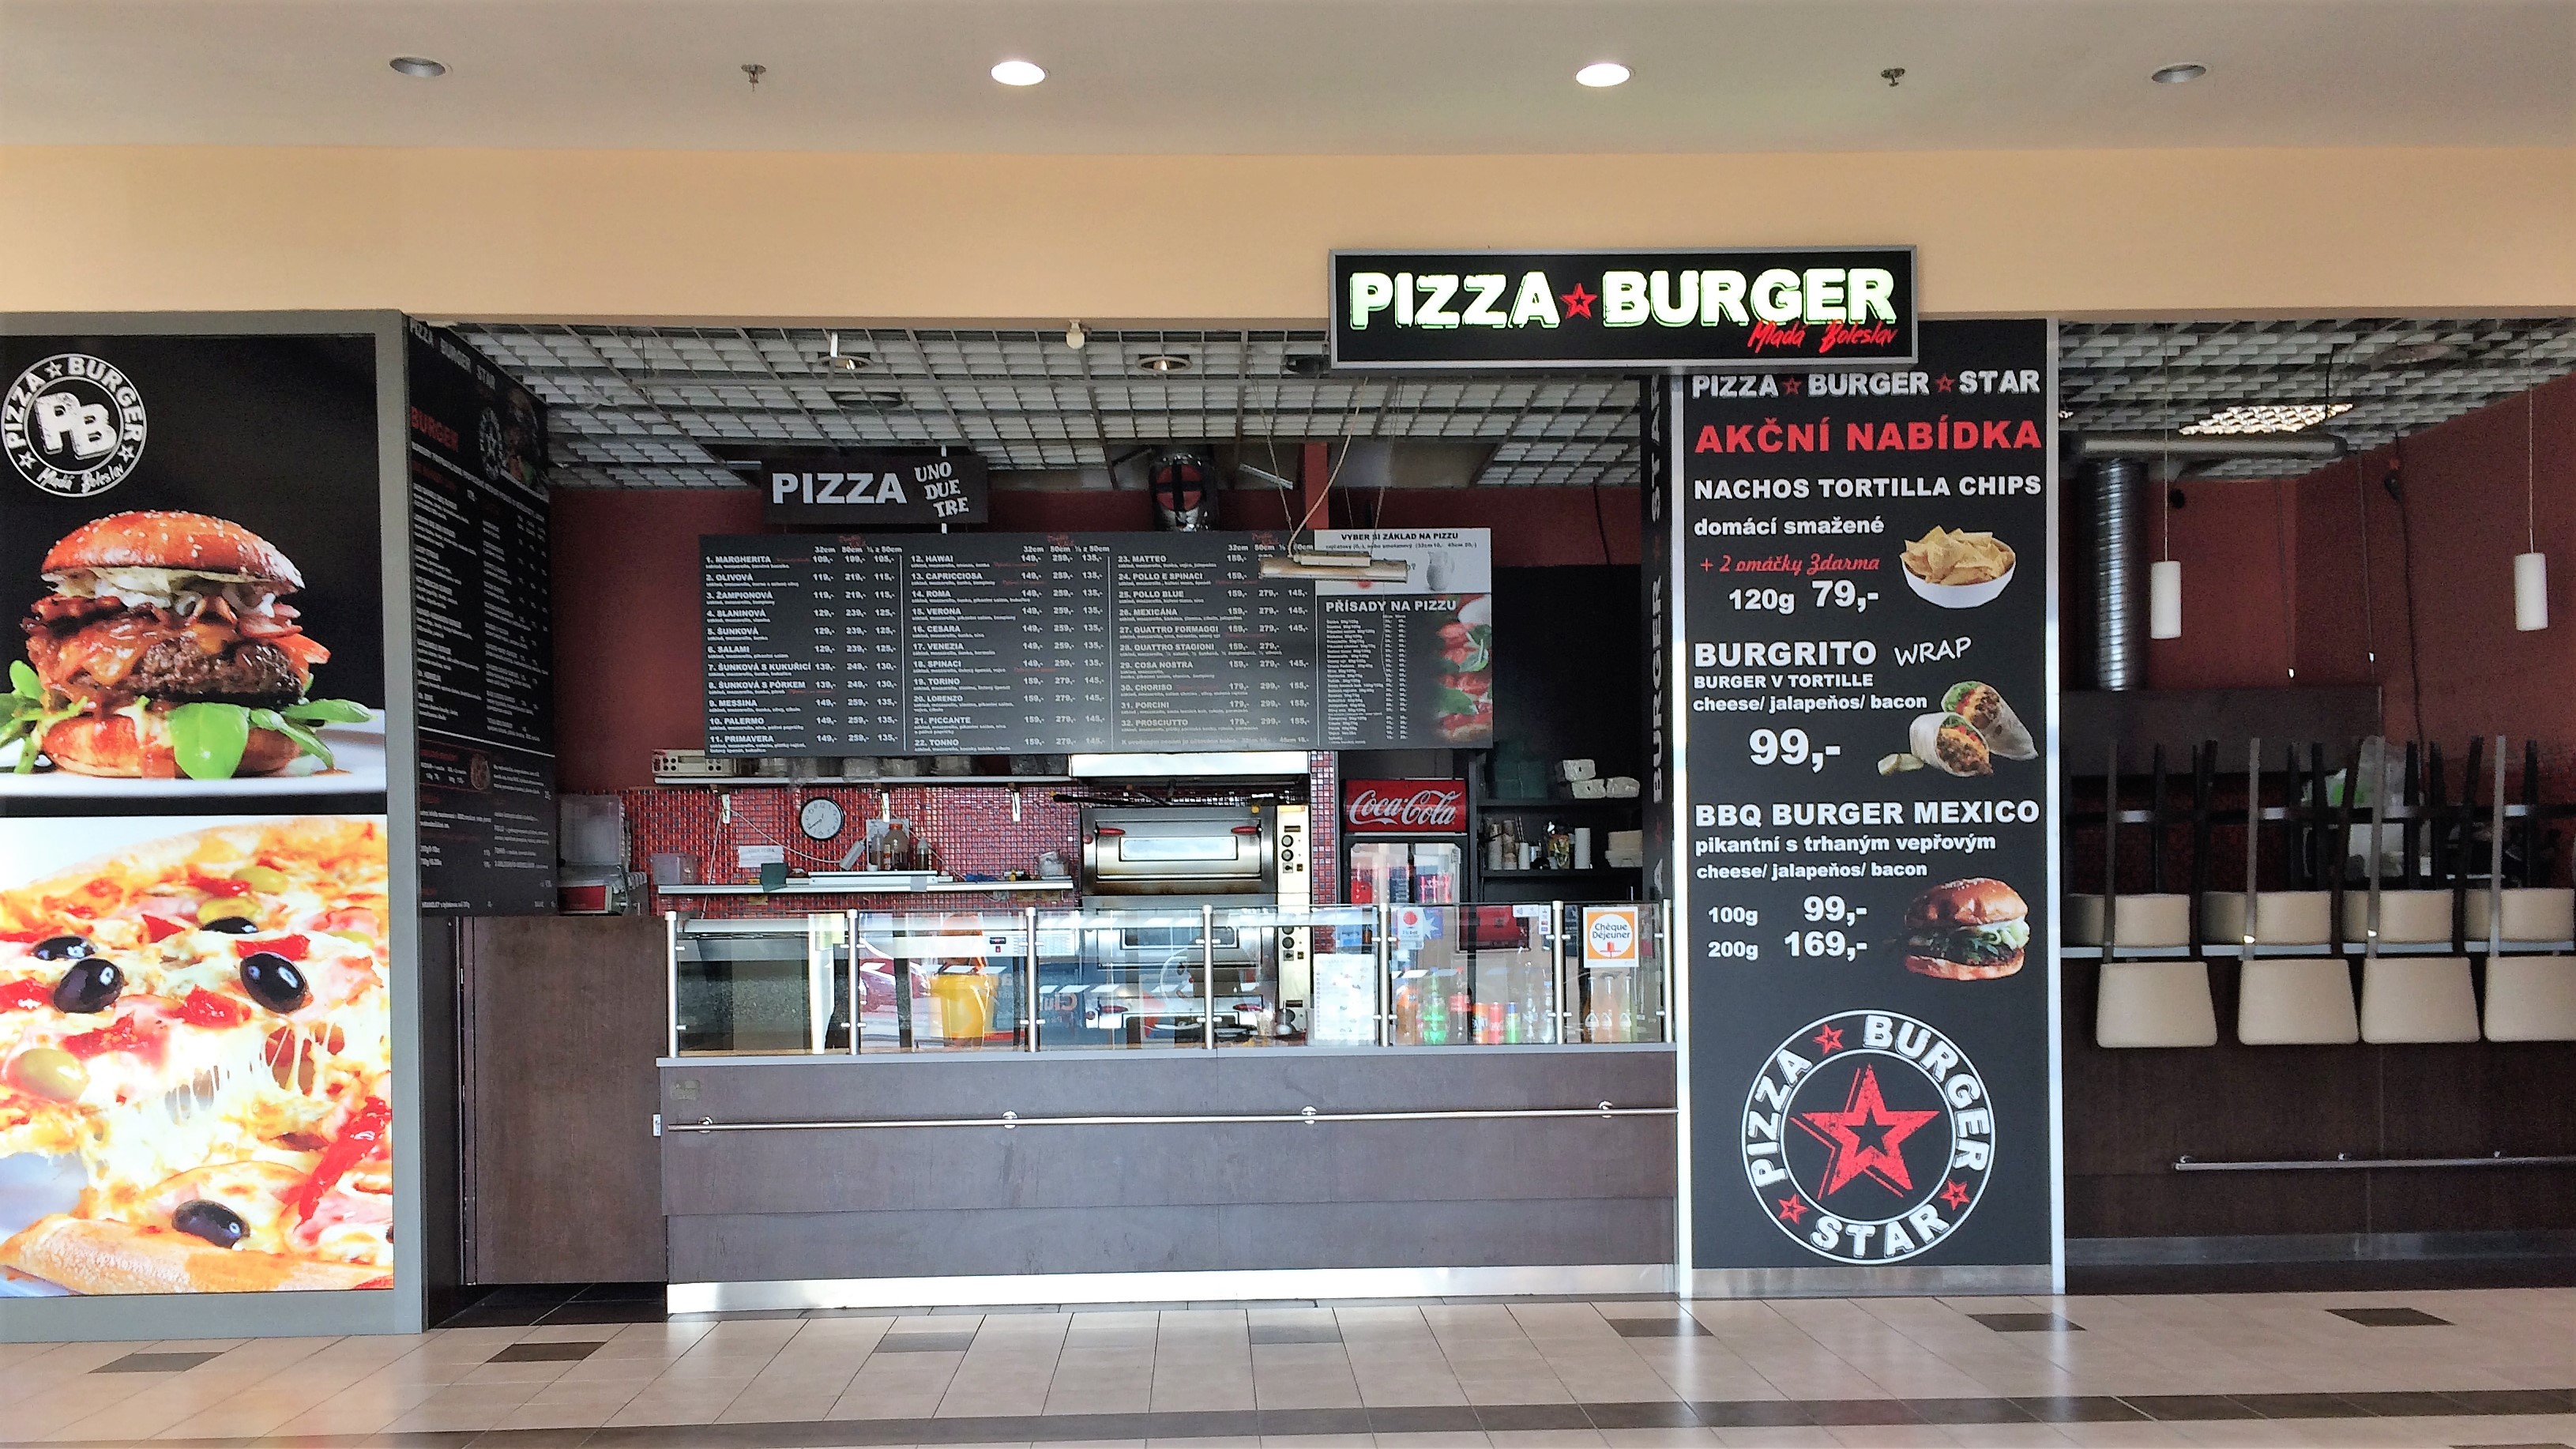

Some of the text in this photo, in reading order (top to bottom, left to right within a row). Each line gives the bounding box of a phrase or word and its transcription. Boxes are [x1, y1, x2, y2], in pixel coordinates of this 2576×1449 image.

[1349, 268, 1896, 330] PIZZA BURGER
[1747, 320, 1899, 353] Mladá Boleslav
[1691, 370, 2040, 399] PIZZA BURGER STAR
[4, 357, 144, 449] PIZZA BURGER
[1694, 416, 2043, 454] AKČNÍ NABÍDKA
[914, 462, 953, 483] UNO
[772, 472, 907, 505] PIZZA
[925, 480, 961, 501] DUE
[1694, 475, 2041, 500] NACHOS TORTILLA CHIPS
[934, 497, 970, 518] TRE
[1694, 516, 1884, 537] domácí smažené
[716, 573, 753, 581] OLIVOVÁ
[1720, 555, 1731, 572] 2
[1734, 555, 1802, 575] omáčky
[1326, 600, 1456, 612] PŘÍSADY NA PIZZU
[1728, 580, 1879, 615] 120g 79,-
[717, 608, 766, 618] SLANINOVÁ
[1694, 637, 1972, 668] BURGRITO WRAP
[717, 662, 759, 671] ŠUNKOVÁ
[769, 662, 810, 671] KUKUŘICÍ
[1652, 574, 1663, 804] BURGER
[1694, 674, 1873, 690] BURGER V TORTILLE
[1693, 696, 1766, 712] cheese/
[1871, 694, 1927, 709] bacon
[1748, 728, 1841, 773] 99,-
[1695, 800, 2040, 828] BBQ BURGER MEXICO
[1694, 834, 1996, 856] pikantní s trhaným vepřovým
[1696, 862, 1768, 879] cheese/
[1871, 861, 1927, 877] bacon
[1707, 896, 1869, 927] 100g 99,-
[1593, 931, 1631, 940] Déjeuner
[1707, 932, 1869, 962] 200g 169,-
[1747, 1014, 1991, 1188] PIZZA BURGER
[1811, 1203, 1952, 1259] STAR
